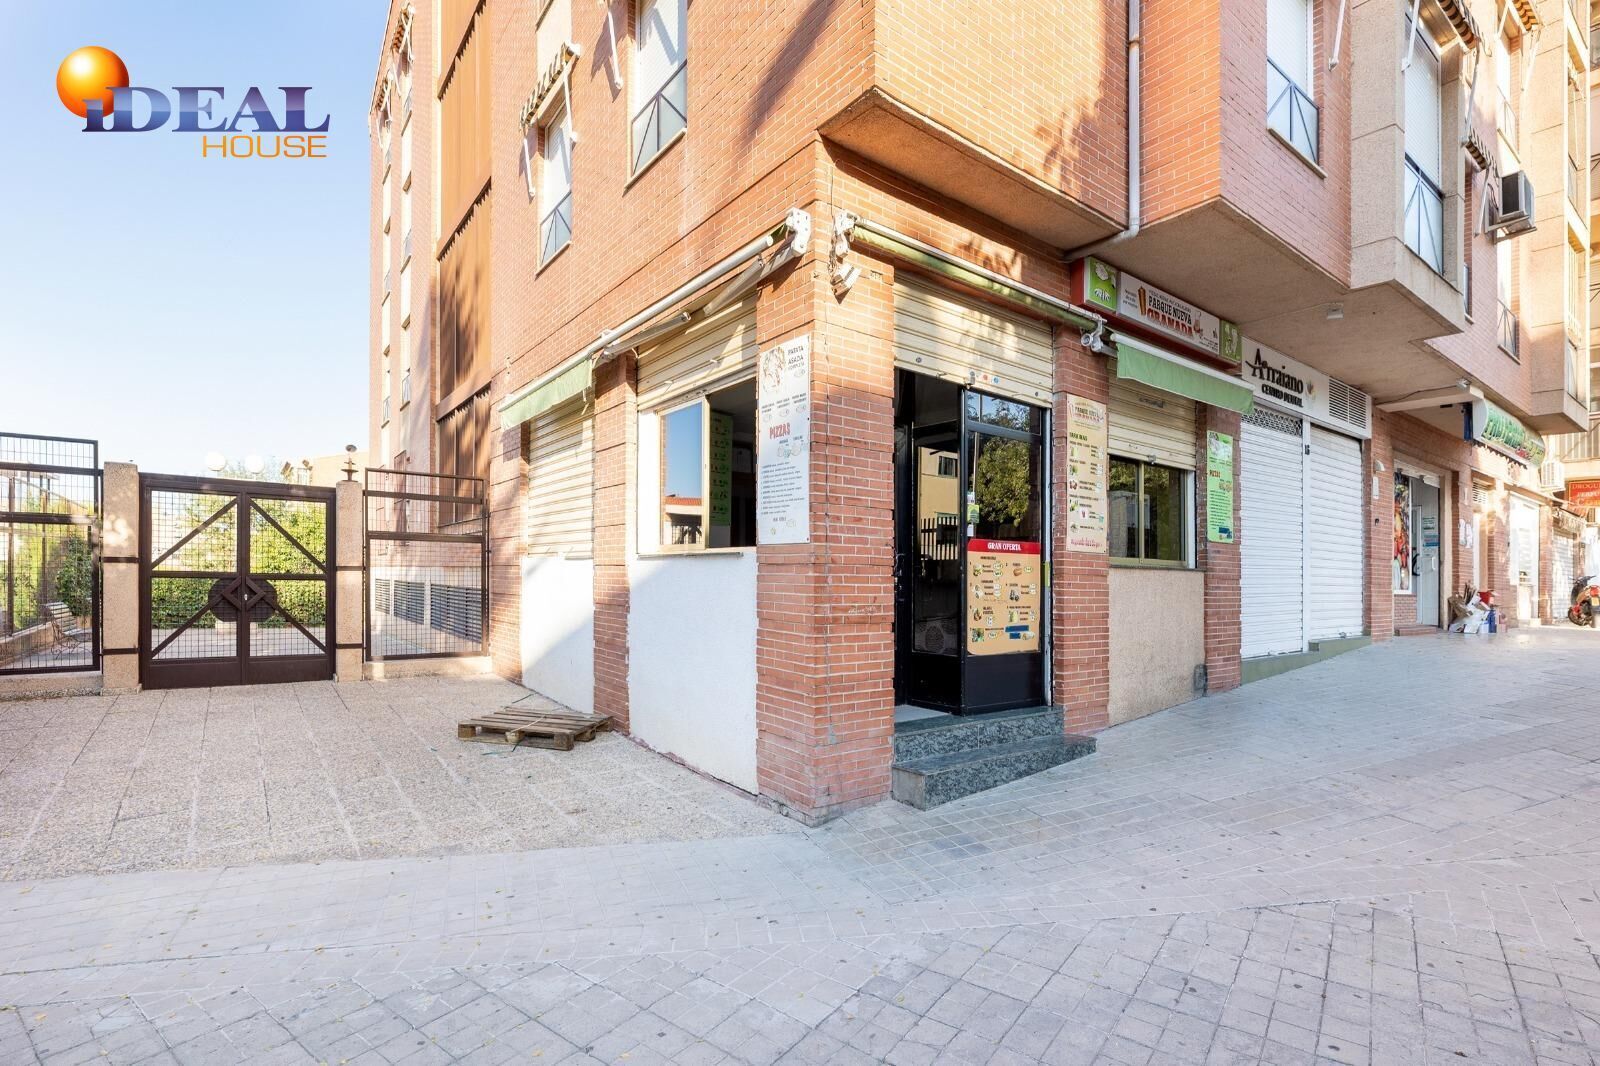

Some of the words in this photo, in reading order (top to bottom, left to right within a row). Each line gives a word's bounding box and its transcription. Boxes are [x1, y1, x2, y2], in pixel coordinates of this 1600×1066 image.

[1146, 307, 1193, 337] GRANADA
[1148, 295, 1172, 316] PARQUE
[1172, 305, 1192, 325] NUEVA
[1245, 348, 1304, 394] Arraiano
[1261, 383, 1284, 400] CENTRO
[1283, 391, 1304, 408] DENTAL
[769, 422, 791, 439] PIZZAS
[987, 542, 1002, 550] GRAN
[1002, 543, 1022, 551] OFERTA
